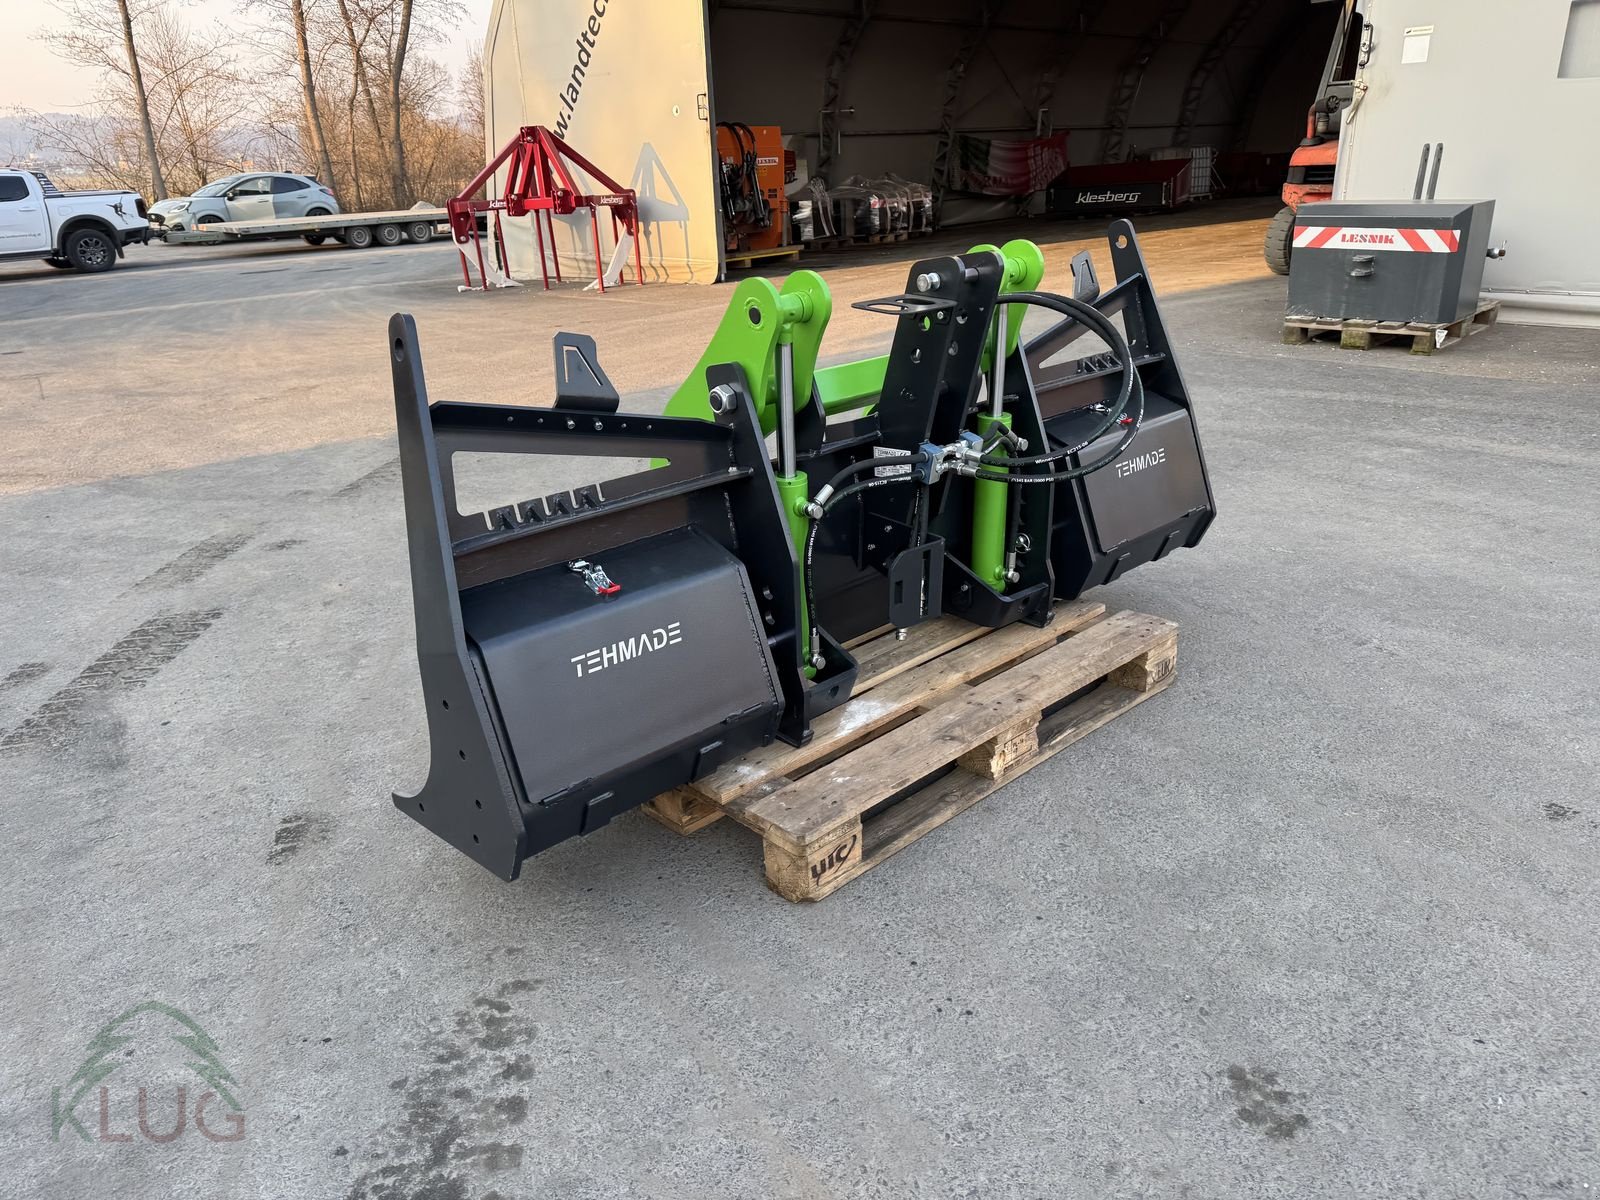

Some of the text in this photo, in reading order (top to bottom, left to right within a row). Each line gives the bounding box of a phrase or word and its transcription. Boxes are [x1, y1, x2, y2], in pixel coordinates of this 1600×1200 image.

[553, 0, 608, 140] w.landtec
[1075, 190, 1142, 203] klesberg
[1341, 234, 1394, 244] LESNIK
[1115, 447, 1166, 478] TEHMADE
[570, 621, 683, 678] TEHMADE
